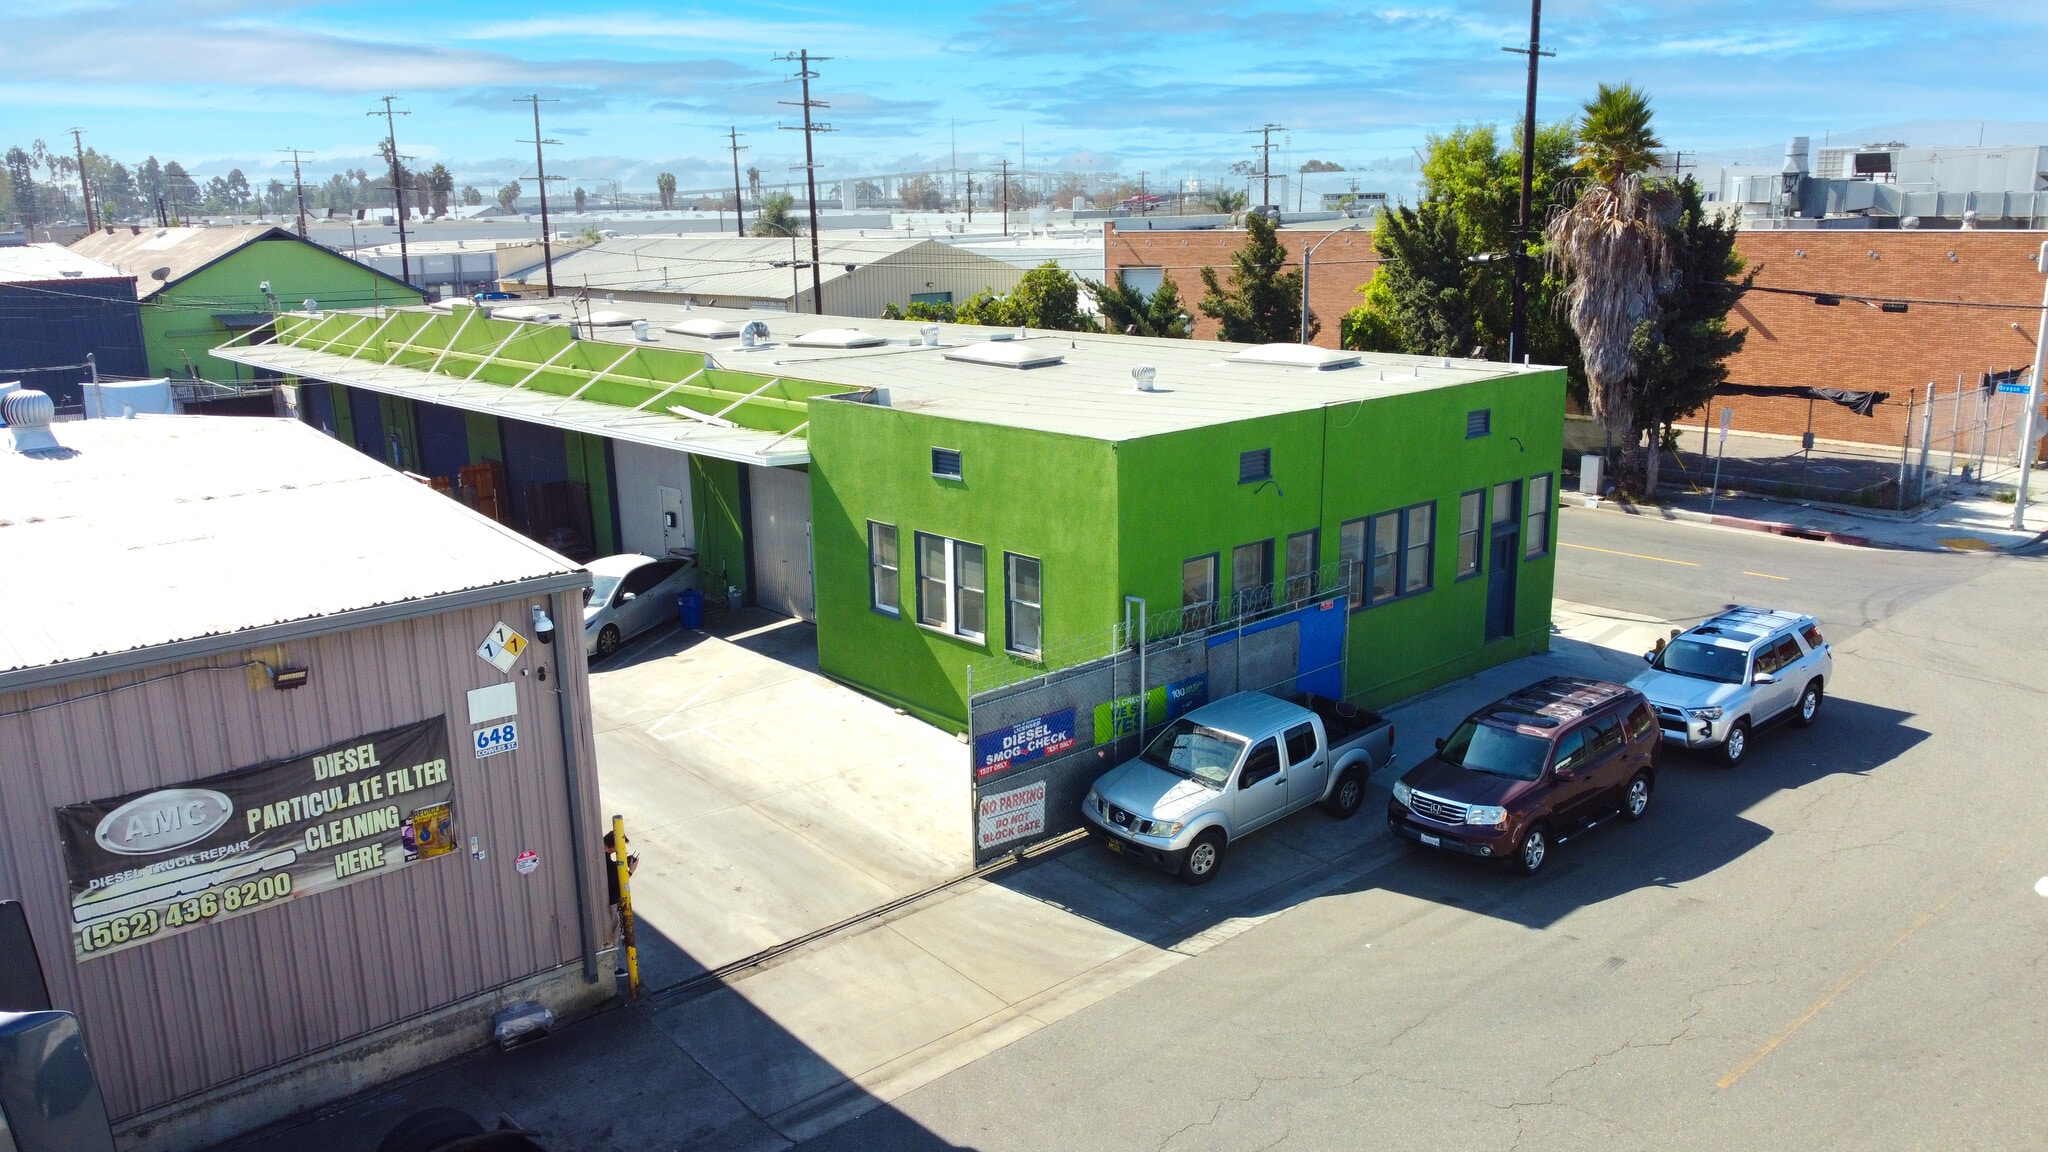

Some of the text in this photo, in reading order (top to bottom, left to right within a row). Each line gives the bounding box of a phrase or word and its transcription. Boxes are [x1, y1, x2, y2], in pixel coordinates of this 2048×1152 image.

[496, 628, 504, 642] 1
[510, 638, 518, 652] 1
[484, 644, 493, 658] 1
[478, 725, 514, 748] 648
[478, 744, 506, 757] COWLES
[986, 730, 1066, 765] SMOG CHECK
[1003, 724, 1051, 749] DIESEL
[312, 744, 380, 781] DIESEL
[246, 758, 448, 834] PARTICULATE FILTER
[982, 786, 1044, 816] NO PARKING
[125, 800, 208, 842] AMC
[304, 805, 400, 852] CLEANING
[983, 820, 1040, 843] BLOCK GATE
[996, 812, 1029, 829] DO NOT
[89, 840, 250, 890] DIESEL TRUCK REPAIR
[334, 843, 386, 880] HERE
[81, 909, 159, 951] (562)
[165, 892, 218, 928] 436
[223, 872, 292, 911] 8200
